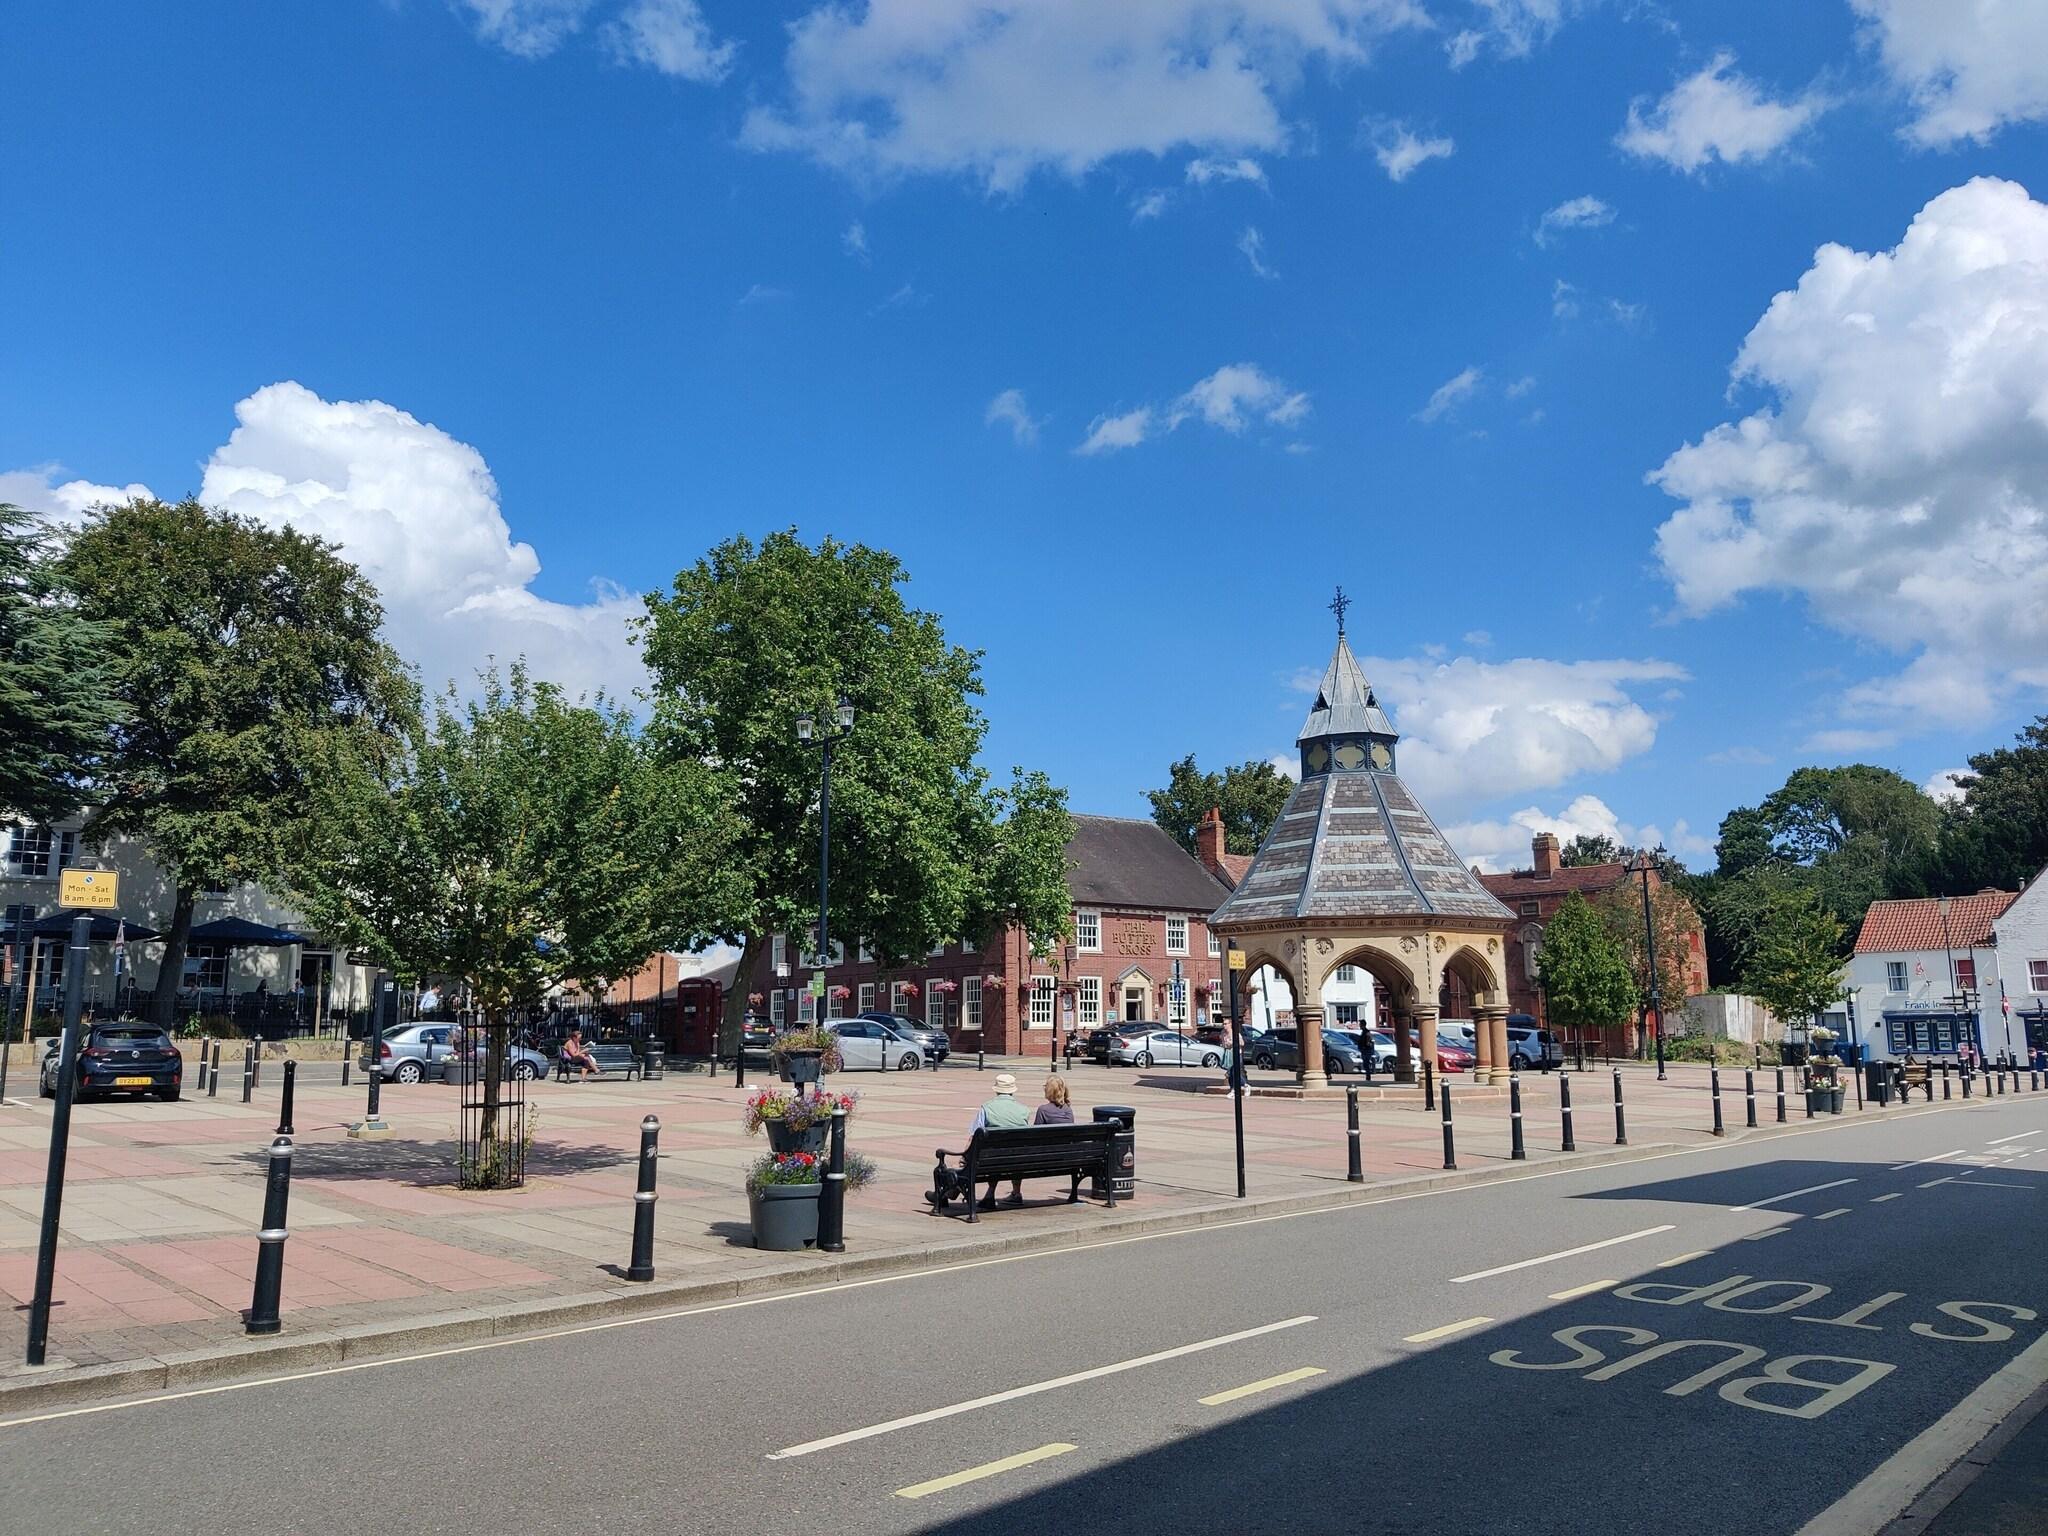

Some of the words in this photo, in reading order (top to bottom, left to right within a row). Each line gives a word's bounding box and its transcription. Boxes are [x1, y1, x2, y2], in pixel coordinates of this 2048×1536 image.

[68, 885, 86, 893] Mon
[95, 885, 109, 893] Sat
[64, 894, 70, 902] 8
[1122, 922, 1146, 932] THE
[1112, 932, 1157, 945] BUTTER
[1118, 944, 1152, 956] CROSS
[1904, 1000, 1931, 1009] Frank
[1612, 1275, 2038, 1342] STOP
[1488, 1325, 1899, 1419] BUS
